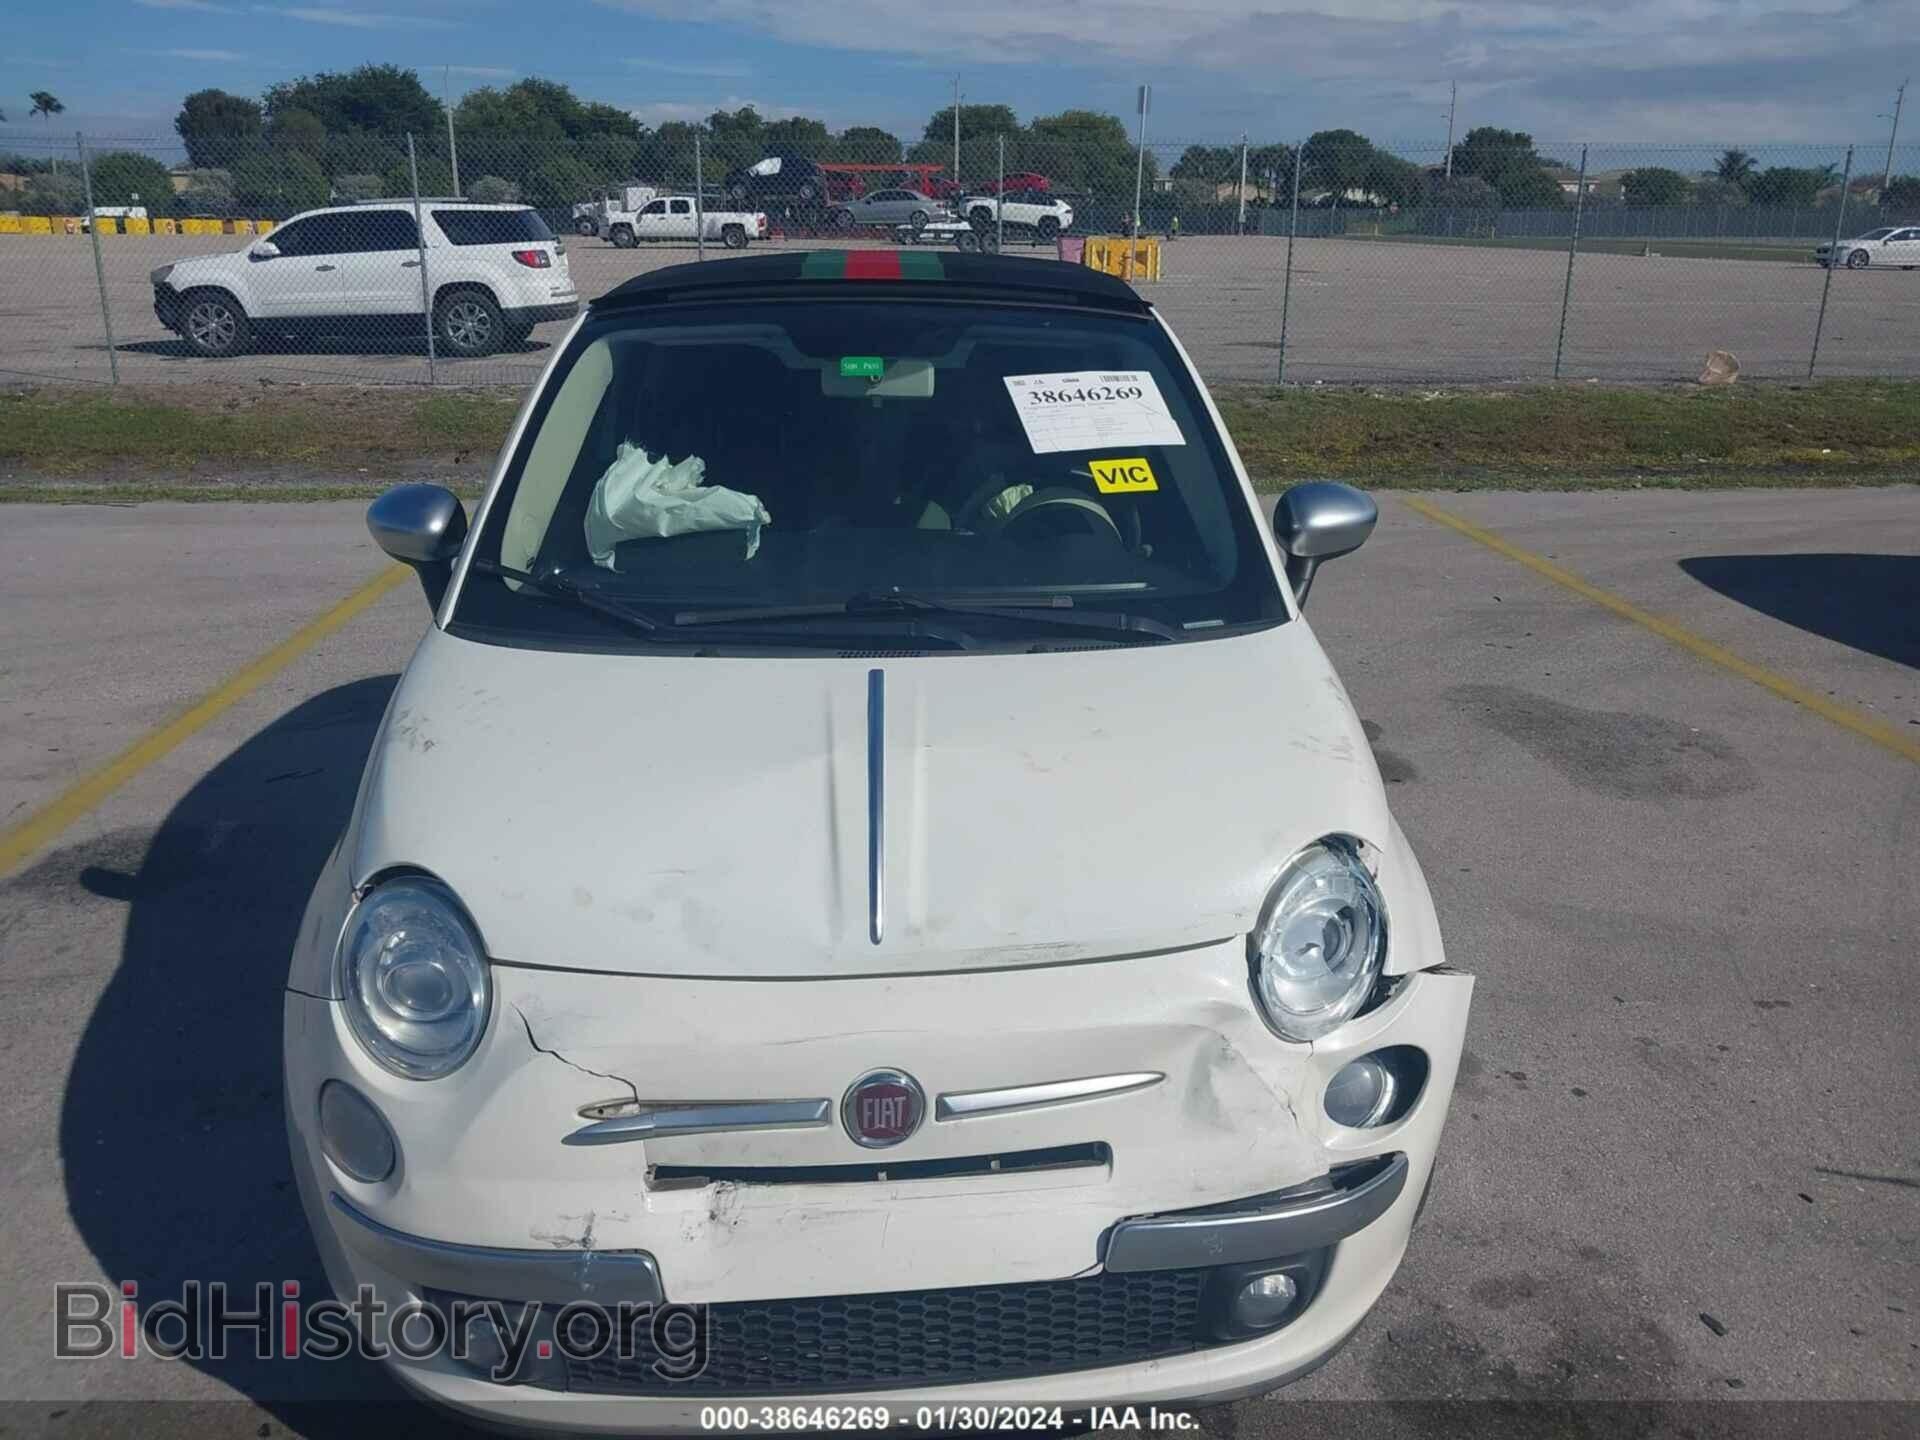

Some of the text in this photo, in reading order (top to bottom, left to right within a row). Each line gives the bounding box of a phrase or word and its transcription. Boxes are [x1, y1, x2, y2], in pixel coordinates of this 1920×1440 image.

[1029, 387, 1142, 405] 38646269
[1097, 466, 1149, 484] VIC
[862, 1096, 906, 1129] FIAT
